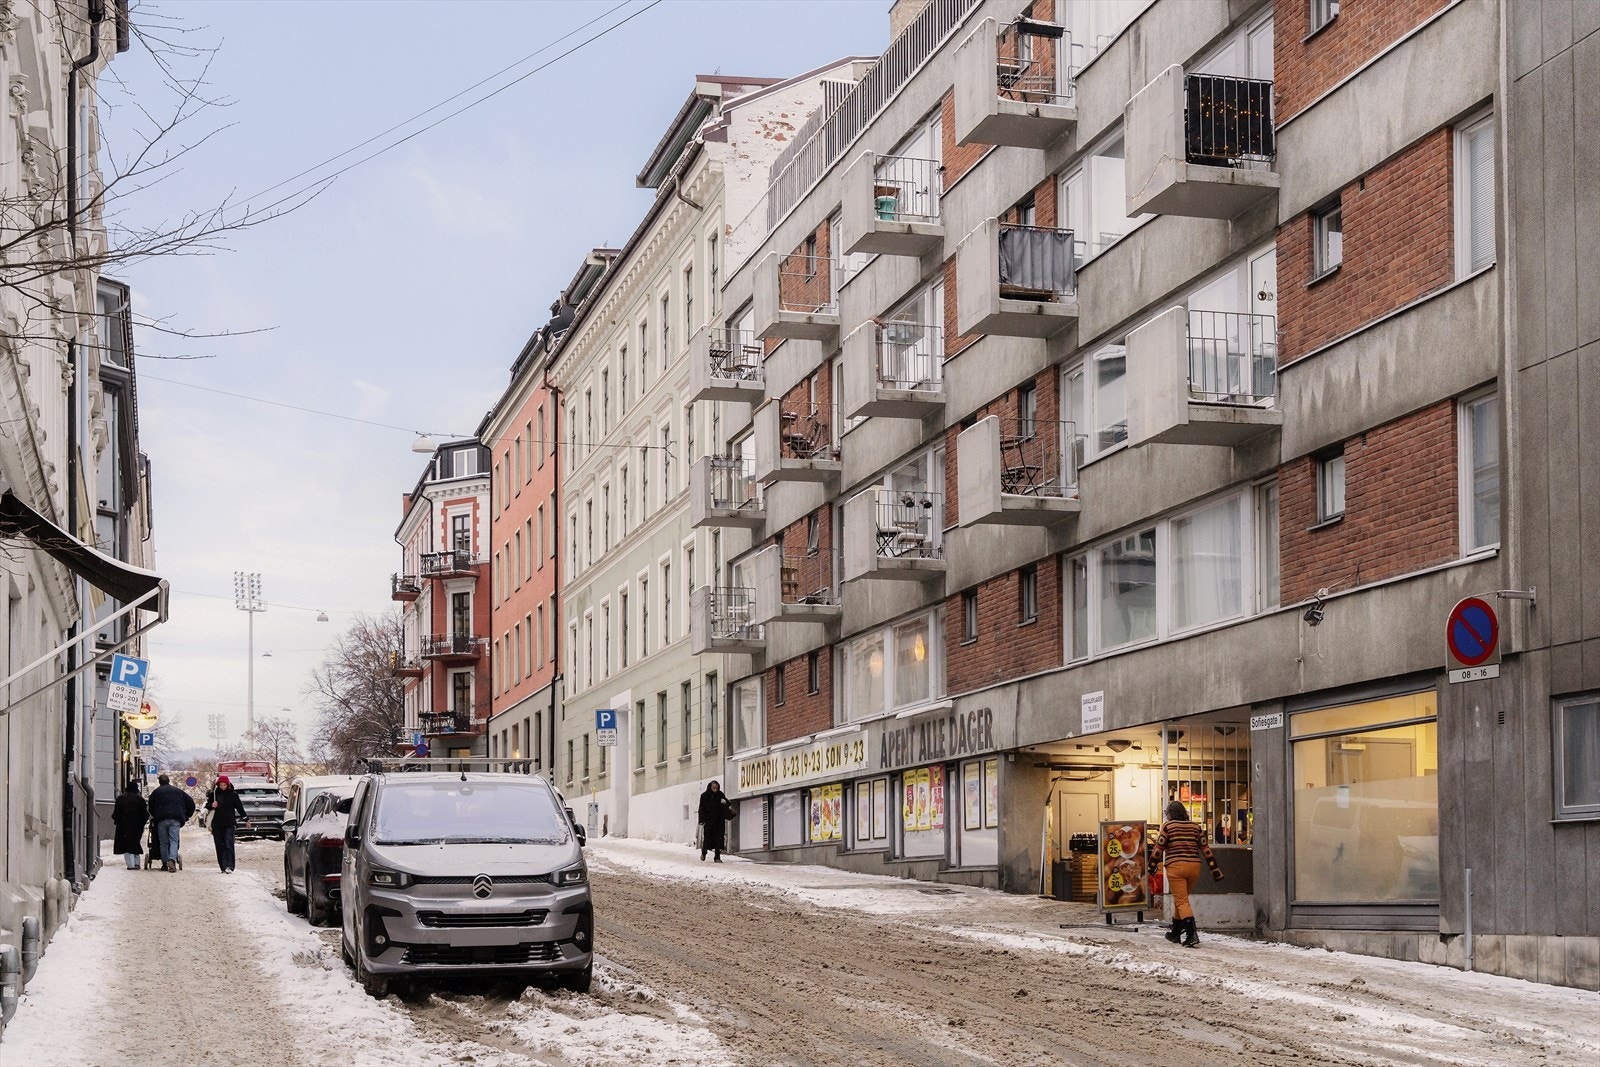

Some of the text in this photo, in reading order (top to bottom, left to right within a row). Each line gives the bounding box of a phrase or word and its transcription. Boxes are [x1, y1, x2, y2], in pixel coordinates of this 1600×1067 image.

[119, 660, 139, 682] P
[601, 712, 611, 727] P
[1252, 716, 1278, 728] Sofiesgate
[142, 735, 150, 744] P
[919, 717, 946, 762] ALLE
[949, 707, 994, 757] DAGER
[741, 758, 778, 788] BUNNPRIS
